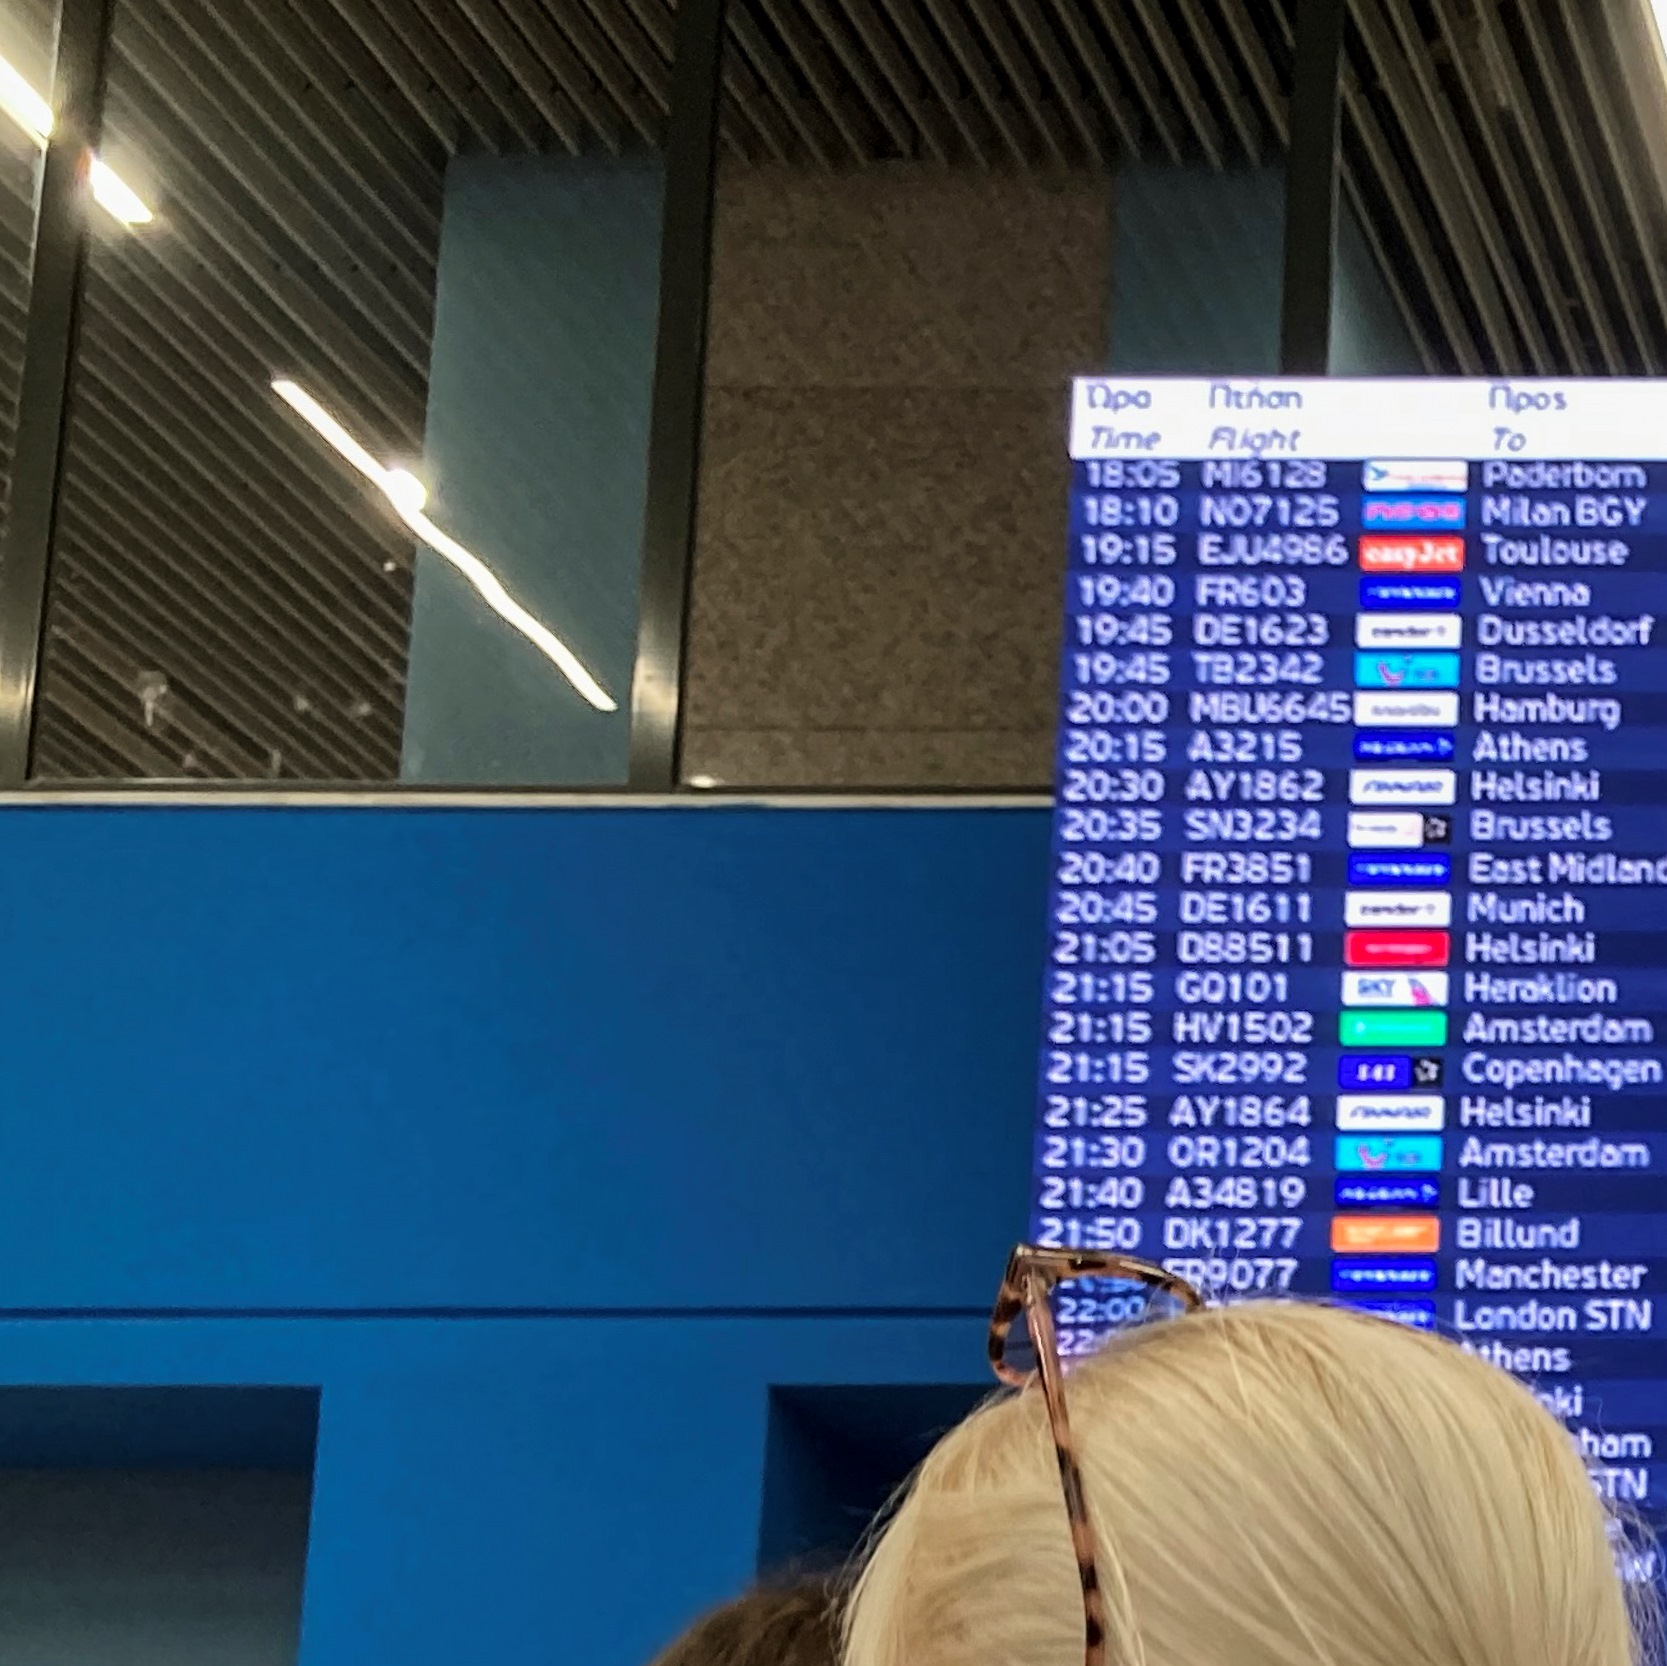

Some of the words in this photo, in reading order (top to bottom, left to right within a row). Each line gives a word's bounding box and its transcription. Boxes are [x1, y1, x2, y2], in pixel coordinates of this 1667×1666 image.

[1091, 426, 1162, 451] Time
[1209, 426, 1301, 457] Flight
[1493, 427, 1526, 450] To
[1088, 462, 1180, 488] 18:05
[1085, 495, 1179, 526] 18:10
[1482, 495, 1569, 527] Milan
[1576, 495, 1647, 527] BGY
[1082, 533, 1176, 565] 19:15
[1482, 533, 1629, 565] Toulouse
[1080, 574, 1175, 607] 19:40
[1480, 577, 1590, 607] Vienna
[1078, 613, 1172, 646] 19:45
[1478, 614, 1654, 645] Dusseldorf
[1076, 652, 1170, 684] 19:45
[1476, 653, 1617, 684] Brussels
[1068, 691, 1169, 724] 20:00
[1474, 693, 1621, 730] Hamburg
[1066, 730, 1166, 762] 20:15
[1473, 731, 1588, 762] Athens
[1063, 769, 1164, 802] 20:30
[1471, 771, 1600, 801] Helsinki
[1061, 808, 1162, 841] 20:35
[1471, 809, 1612, 841] Brussels
[1058, 851, 1160, 884] 20:40
[1470, 852, 1543, 884] East
[1056, 891, 1158, 924] 20:45
[1467, 892, 1585, 923] Munich
[1054, 931, 1156, 964] 21:05
[1466, 932, 1595, 963] Helsinki
[1051, 970, 1154, 1003] 21:15
[1464, 972, 1617, 1003] Heraklion
[1049, 1011, 1152, 1044] 21:15
[1463, 1012, 1652, 1043] Amsterdam
[1047, 1051, 1149, 1083] 21:15
[1462, 1051, 1661, 1090] Copenhagen
[1045, 1095, 1147, 1128] 21:25
[1460, 1096, 1591, 1127] Helsinki
[1042, 1135, 1145, 1168] 21:30
[1459, 1136, 1649, 1168] Amsterdam
[1040, 1176, 1143, 1209] 21:40
[1459, 1177, 1534, 1208] Lille
[1036, 1216, 1141, 1251] 21:50
[1457, 1217, 1580, 1249] Billund
[1455, 1258, 1648, 1290] Manchester
[1456, 1298, 1576, 1331] London
[1585, 1298, 1652, 1331] STN
